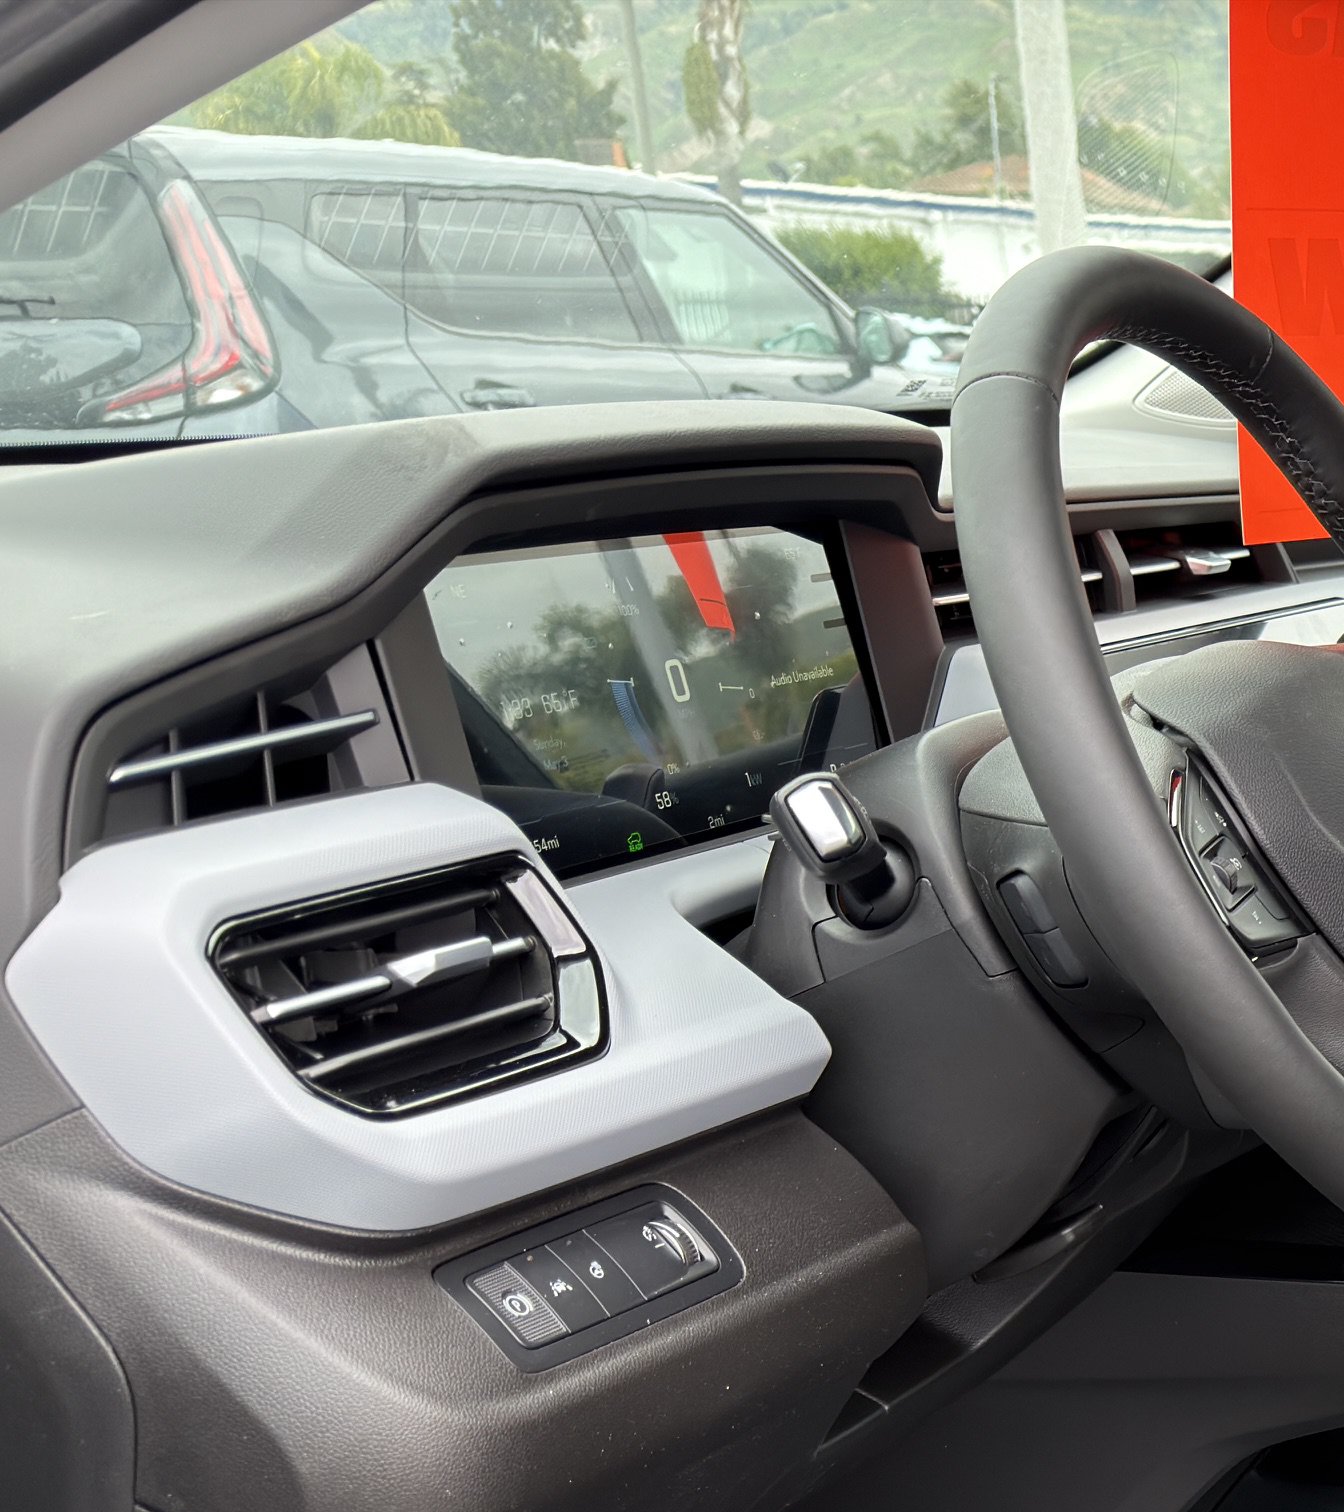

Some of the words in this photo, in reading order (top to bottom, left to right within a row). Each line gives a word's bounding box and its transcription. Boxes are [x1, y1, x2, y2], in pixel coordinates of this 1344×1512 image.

[665, 658, 691, 703] 0
[771, 672, 792, 688] Audio
[792, 666, 834, 682] Unavailable
[533, 834, 560, 854] 54mi
